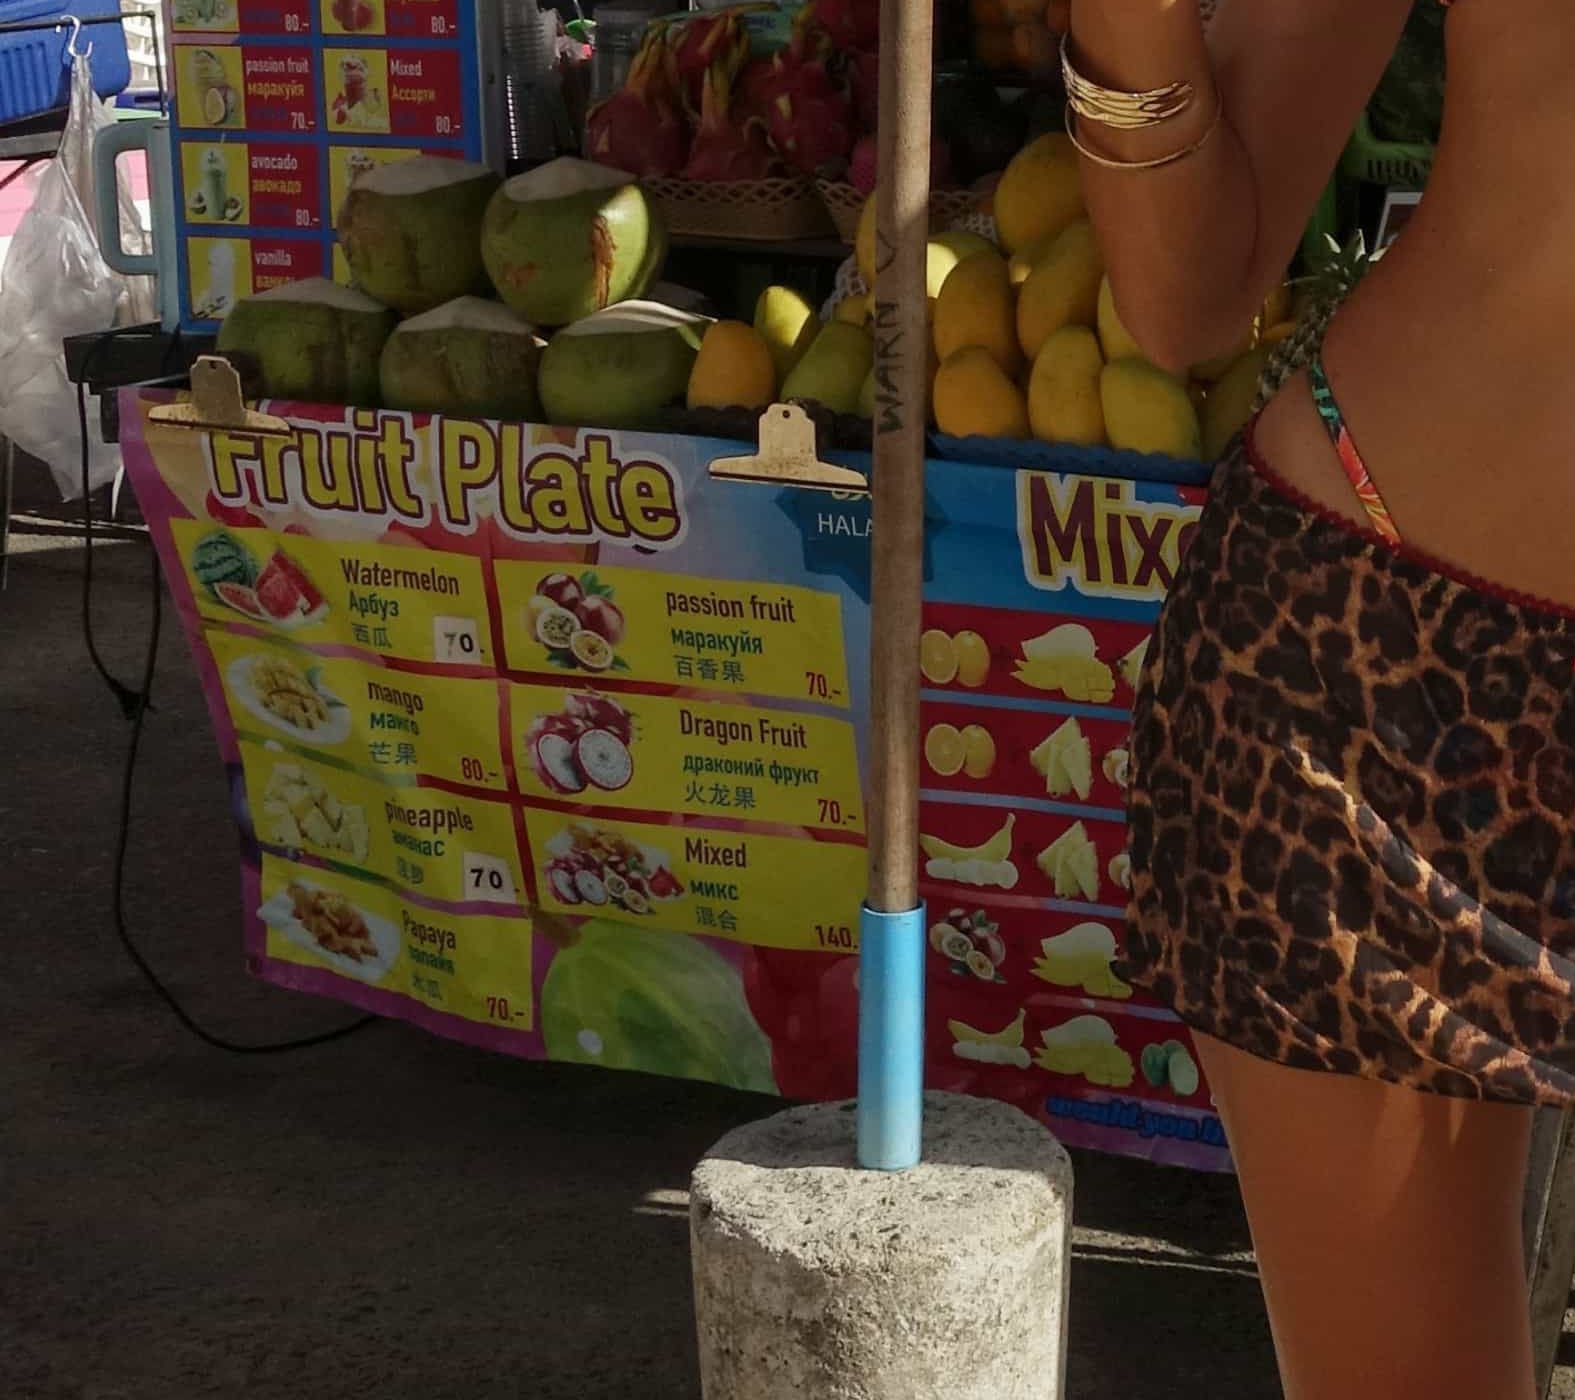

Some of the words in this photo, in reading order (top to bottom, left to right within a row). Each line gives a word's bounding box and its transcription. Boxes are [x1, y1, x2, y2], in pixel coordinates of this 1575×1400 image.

[285, 15, 309, 31] 80.-
[432, 16, 457, 33] 80.-
[245, 58, 284, 74] passion
[286, 59, 309, 73] fruit
[390, 60, 422, 77] Mixed
[292, 112, 315, 129] 70.-
[436, 116, 461, 133] 80.-
[251, 154, 297, 171] avocado
[296, 210, 320, 225] 80.-
[209, 409, 419, 519] Fruit
[437, 421, 680, 542] Plate
[341, 557, 460, 595] Watermelon
[349, 591, 400, 618] Арбуз
[667, 588, 742, 621] passion
[750, 598, 795, 623] fruit
[350, 622, 392, 650] 西瓜
[671, 628, 764, 654] маракуйя
[673, 656, 745, 683] 百香果
[367, 680, 424, 713] mango
[805, 671, 841, 699] 70.-
[680, 708, 751, 745] Dragon
[757, 719, 807, 751] Fruit
[368, 741, 418, 766] 芒果
[461, 757, 497, 783] 80.-
[682, 752, 765, 782] драконий
[685, 783, 757, 810] 火龙果
[385, 799, 473, 835] pineapple
[817, 800, 857, 825] 70.-
[685, 837, 747, 868] Mixed
[689, 880, 739, 902] микс
[402, 908, 456, 953] Papaya
[694, 907, 739, 932] 混合
[486, 996, 525, 1022] 70.-
